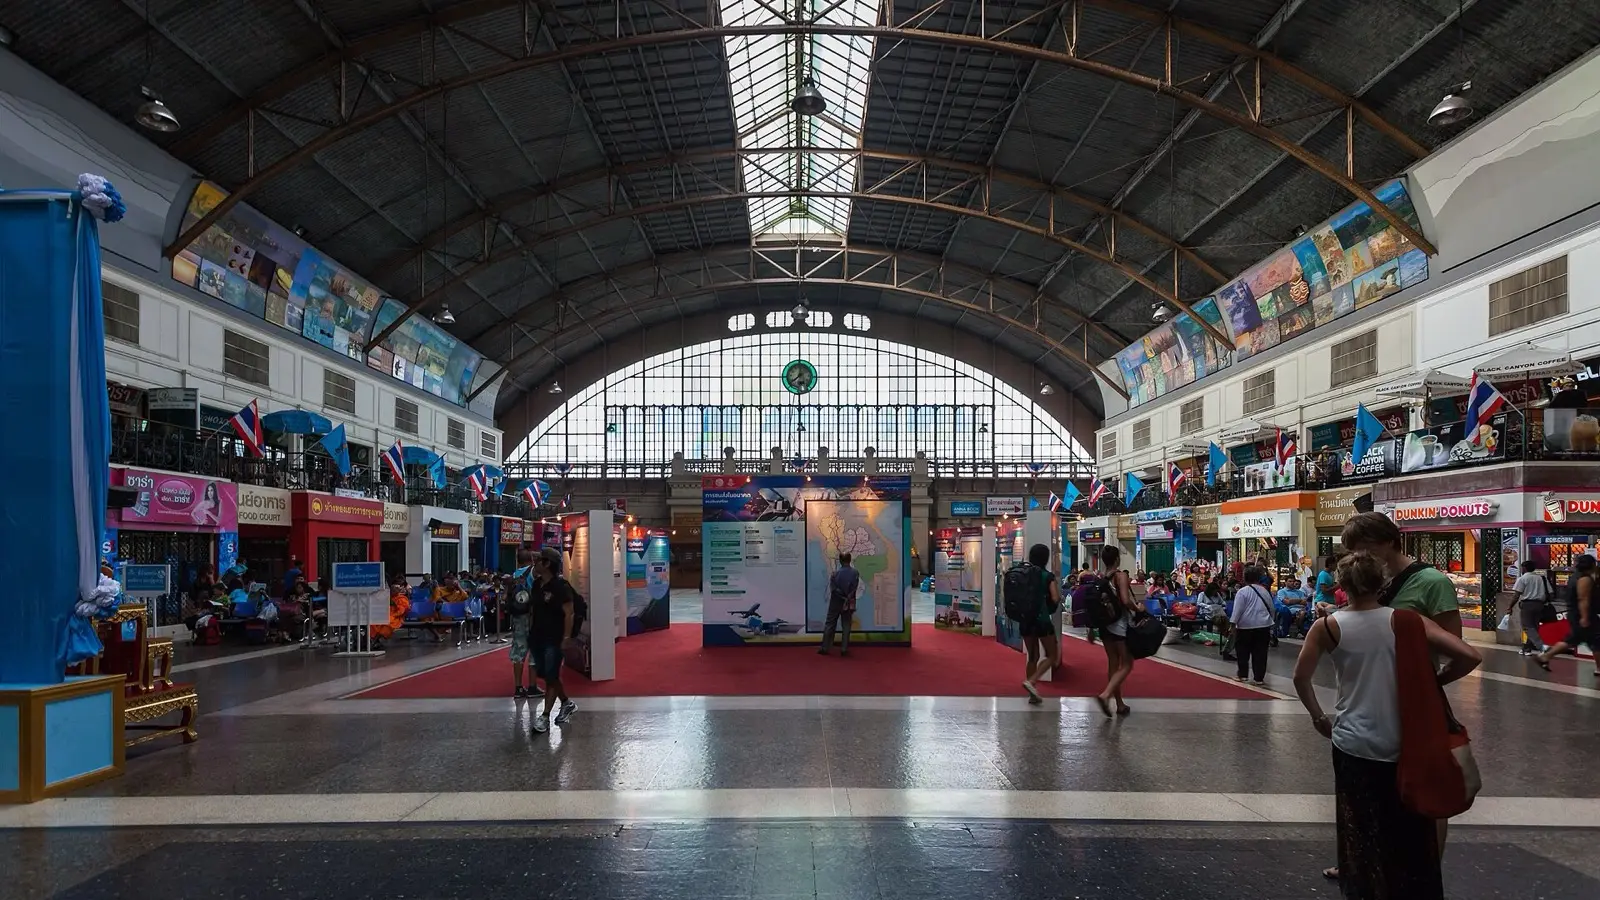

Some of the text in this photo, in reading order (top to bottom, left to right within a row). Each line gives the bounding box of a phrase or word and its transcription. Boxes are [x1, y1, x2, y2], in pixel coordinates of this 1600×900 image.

[1477, 357, 1566, 374] BLACK CANYON COFFEE
[1576, 366, 1600, 382] BL
[1356, 464, 1384, 474] COFFEE
[127, 475, 154, 489] ซาร่า
[238, 491, 286, 511] นย์อาหาร
[1567, 500, 1600, 514] DUN
[260, 514, 281, 522] COURT
[384, 507, 408, 521] ย์อาหาร
[1319, 512, 1346, 523] Grocery
[1396, 503, 1489, 520] DUNKIN' DONUTS
[1243, 517, 1274, 528] KUDSAN
